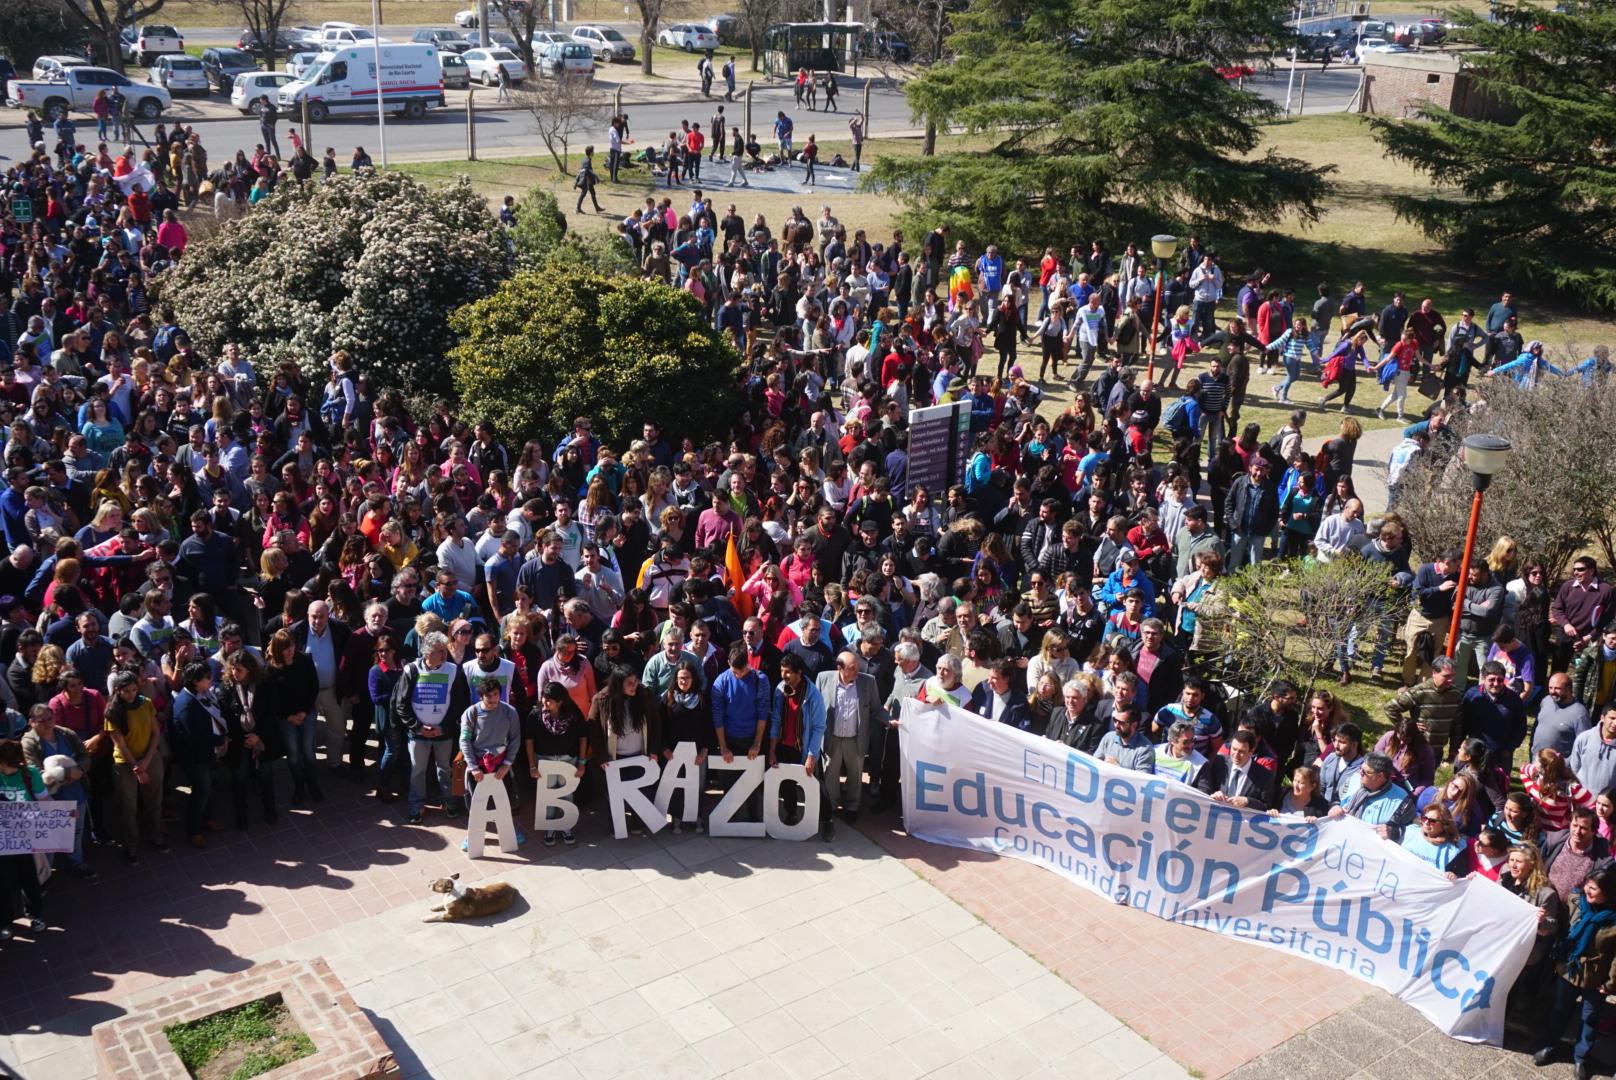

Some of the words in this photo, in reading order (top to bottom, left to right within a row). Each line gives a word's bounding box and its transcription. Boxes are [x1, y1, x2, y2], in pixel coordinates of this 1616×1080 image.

[14, 820, 32, 829] NO
[35, 830, 49, 839] DE
[915, 760, 1239, 905] Educación
[1261, 862, 1496, 1013] Pública
[1024, 748, 1058, 790] En
[1065, 751, 1319, 862] Defensa
[1323, 836, 1365, 882] de
[1374, 858, 1400, 902] la
[994, 826, 1151, 913] Comunidad
[1159, 897, 1377, 979] Universitaria
